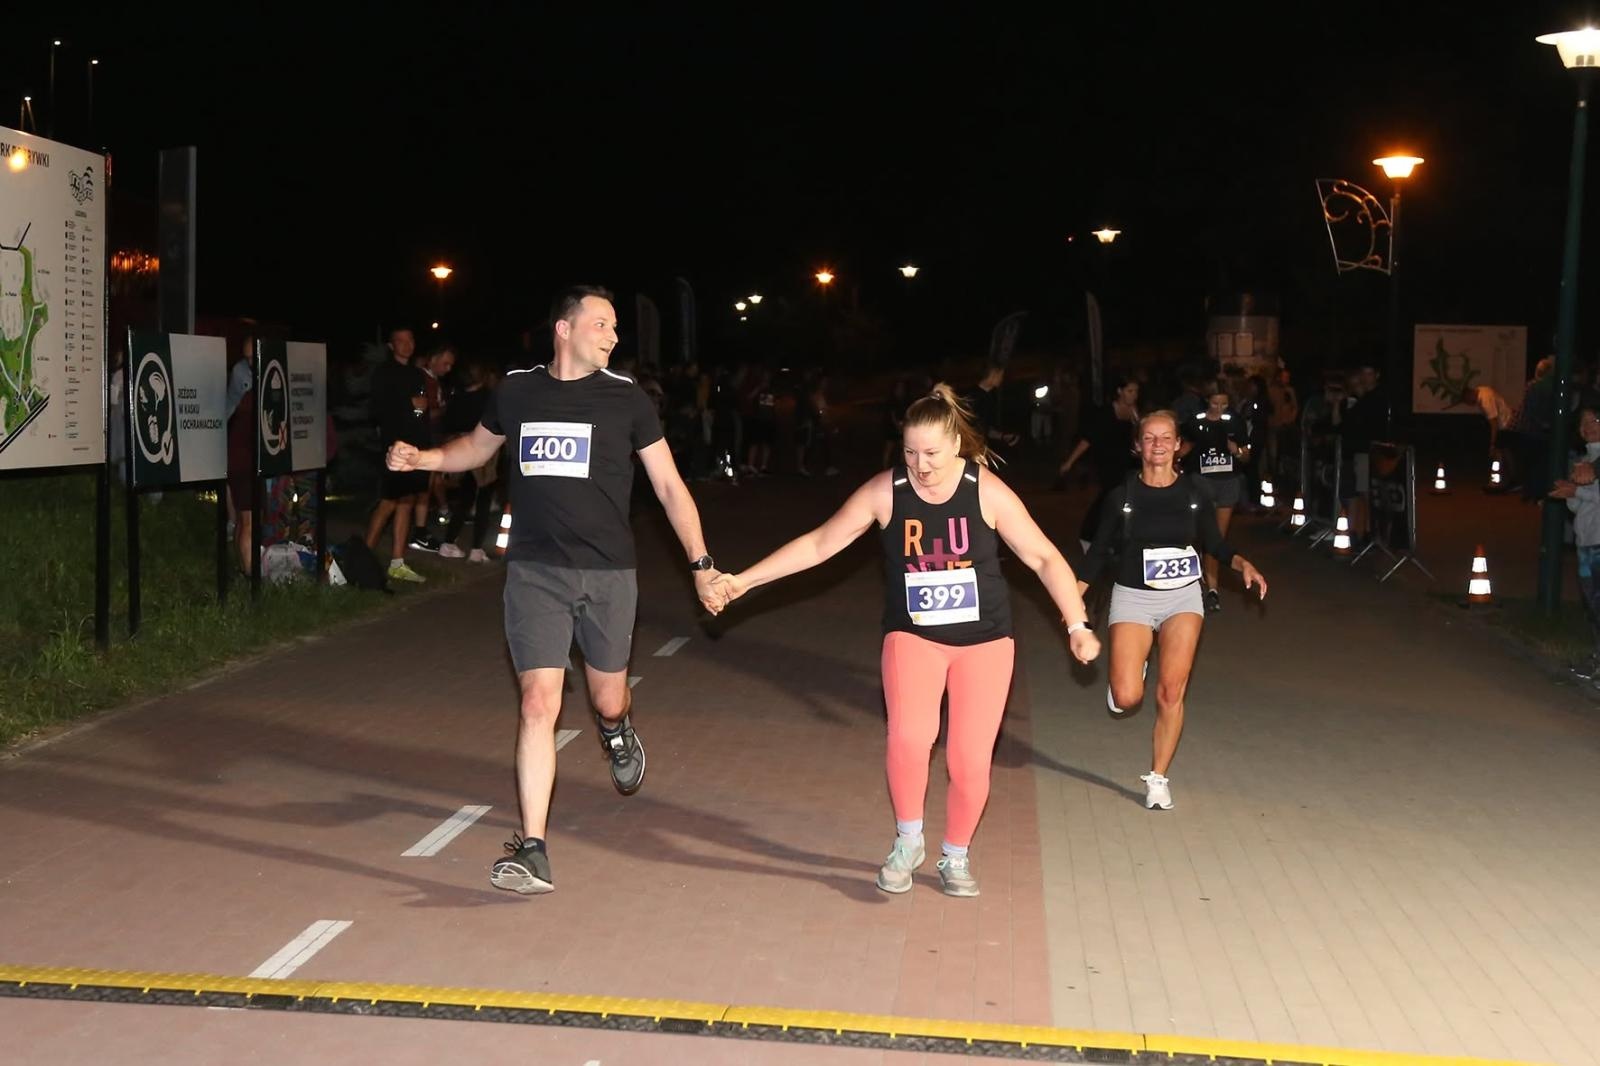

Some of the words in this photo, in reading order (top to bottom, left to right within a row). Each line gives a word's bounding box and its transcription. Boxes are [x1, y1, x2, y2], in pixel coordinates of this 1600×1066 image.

[529, 437, 577, 460] 400
[1155, 558, 1191, 579] 233
[919, 585, 965, 610] 399
